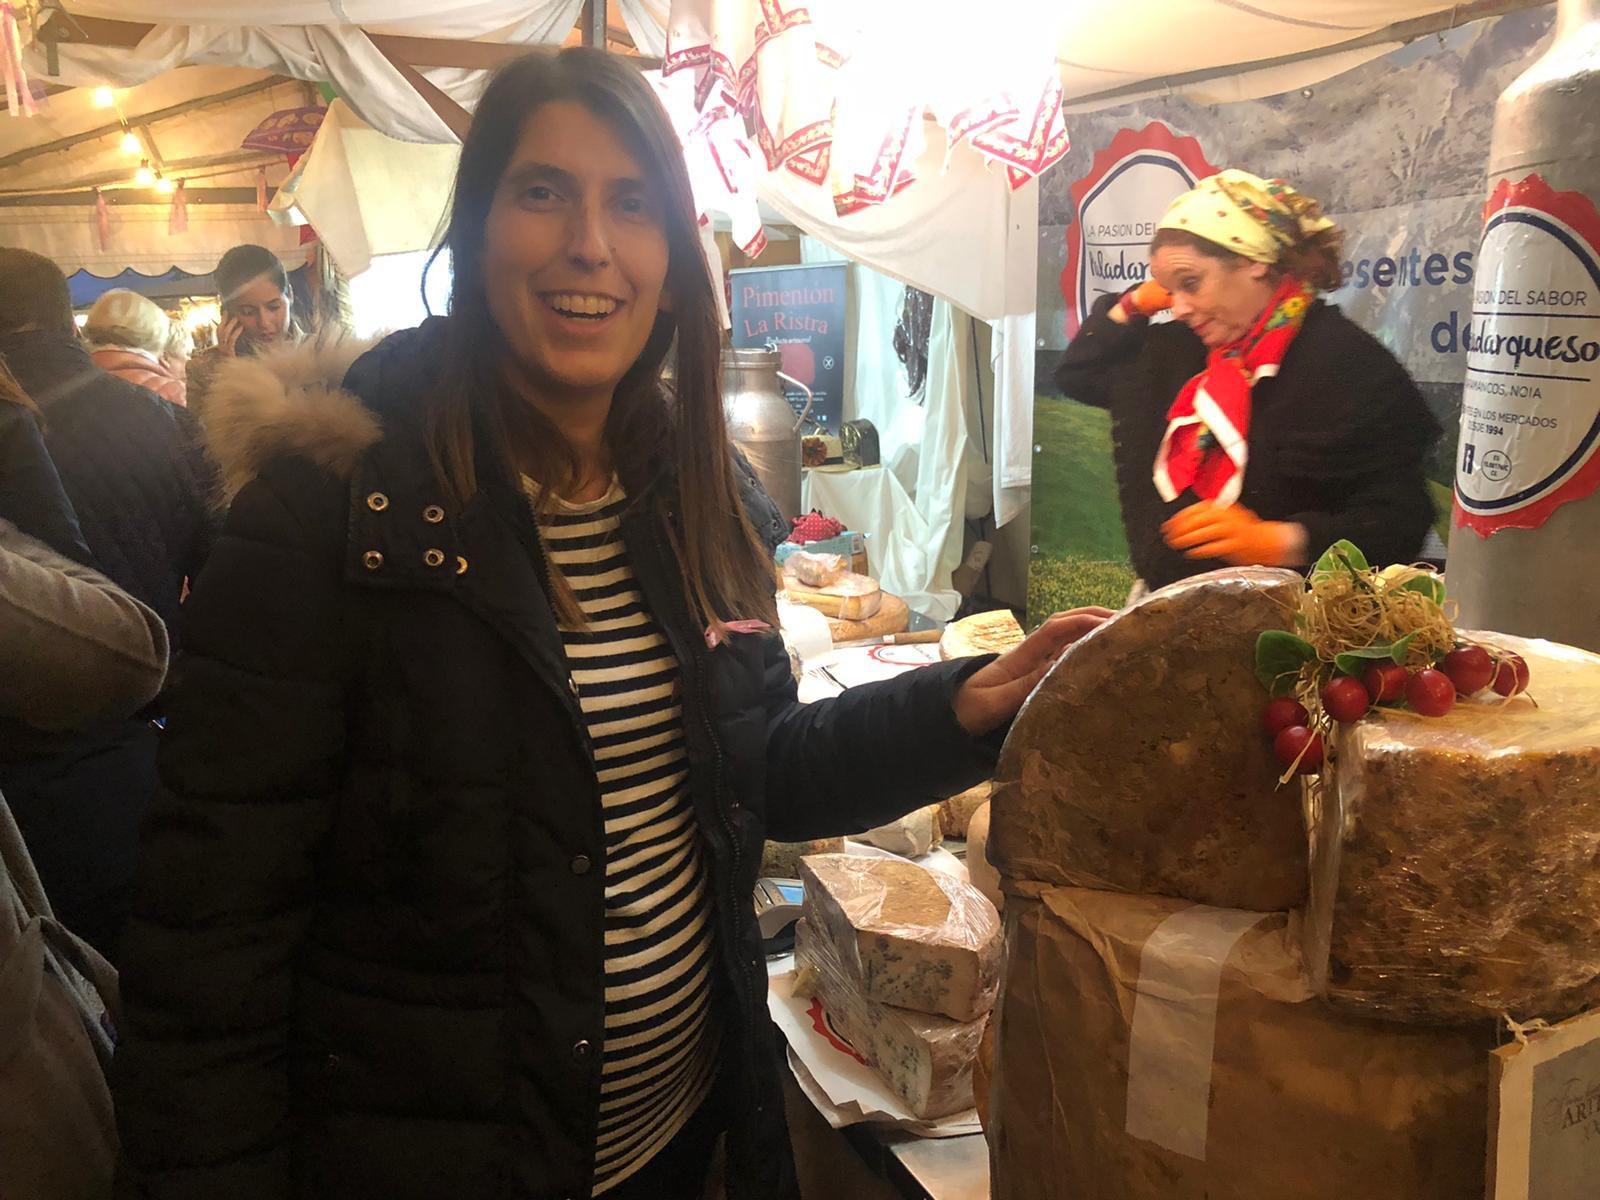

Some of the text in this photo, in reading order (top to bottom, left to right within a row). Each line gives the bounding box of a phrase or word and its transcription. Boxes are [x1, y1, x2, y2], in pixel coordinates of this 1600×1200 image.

[1136, 222, 1157, 236] DEL
[1088, 250, 1150, 281] Madar
[1341, 247, 1474, 289] esentes
[1498, 289, 1522, 305] DEL
[1526, 289, 1588, 307] SABOR
[744, 311, 829, 337] La Ristra
[1510, 385, 1543, 399] NOIA
[1482, 409, 1497, 421] LOS
[1498, 412, 1558, 429] MERCADOS
[1485, 423, 1504, 436] 1994
